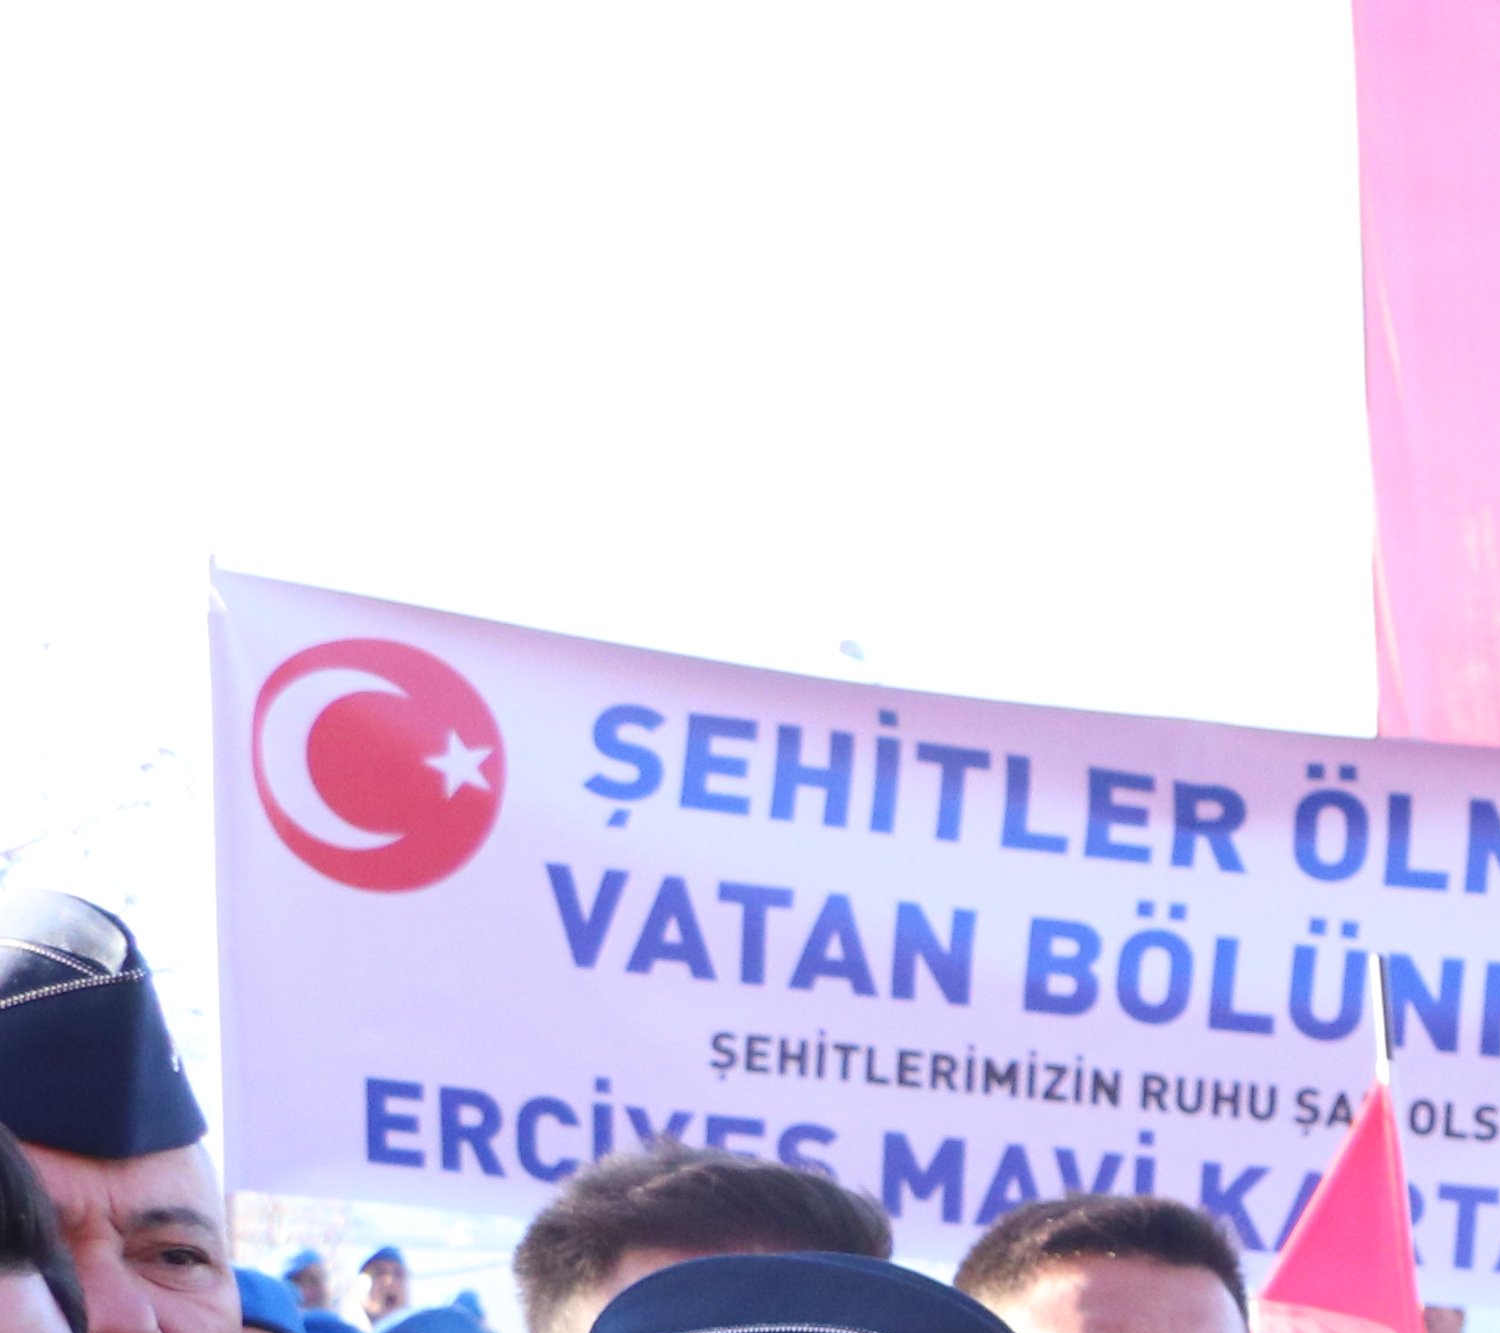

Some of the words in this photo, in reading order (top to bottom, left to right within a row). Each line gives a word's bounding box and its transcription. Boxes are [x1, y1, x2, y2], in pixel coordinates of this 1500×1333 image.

[583, 703, 1247, 874] ŞEHİTLER
[545, 862, 978, 1007] VATAN
[709, 1029, 1123, 1107] ŞEHİTLERİMİZİN
[1140, 1074, 1278, 1121] RUHU
[1295, 1088, 1368, 1136] ŞA
